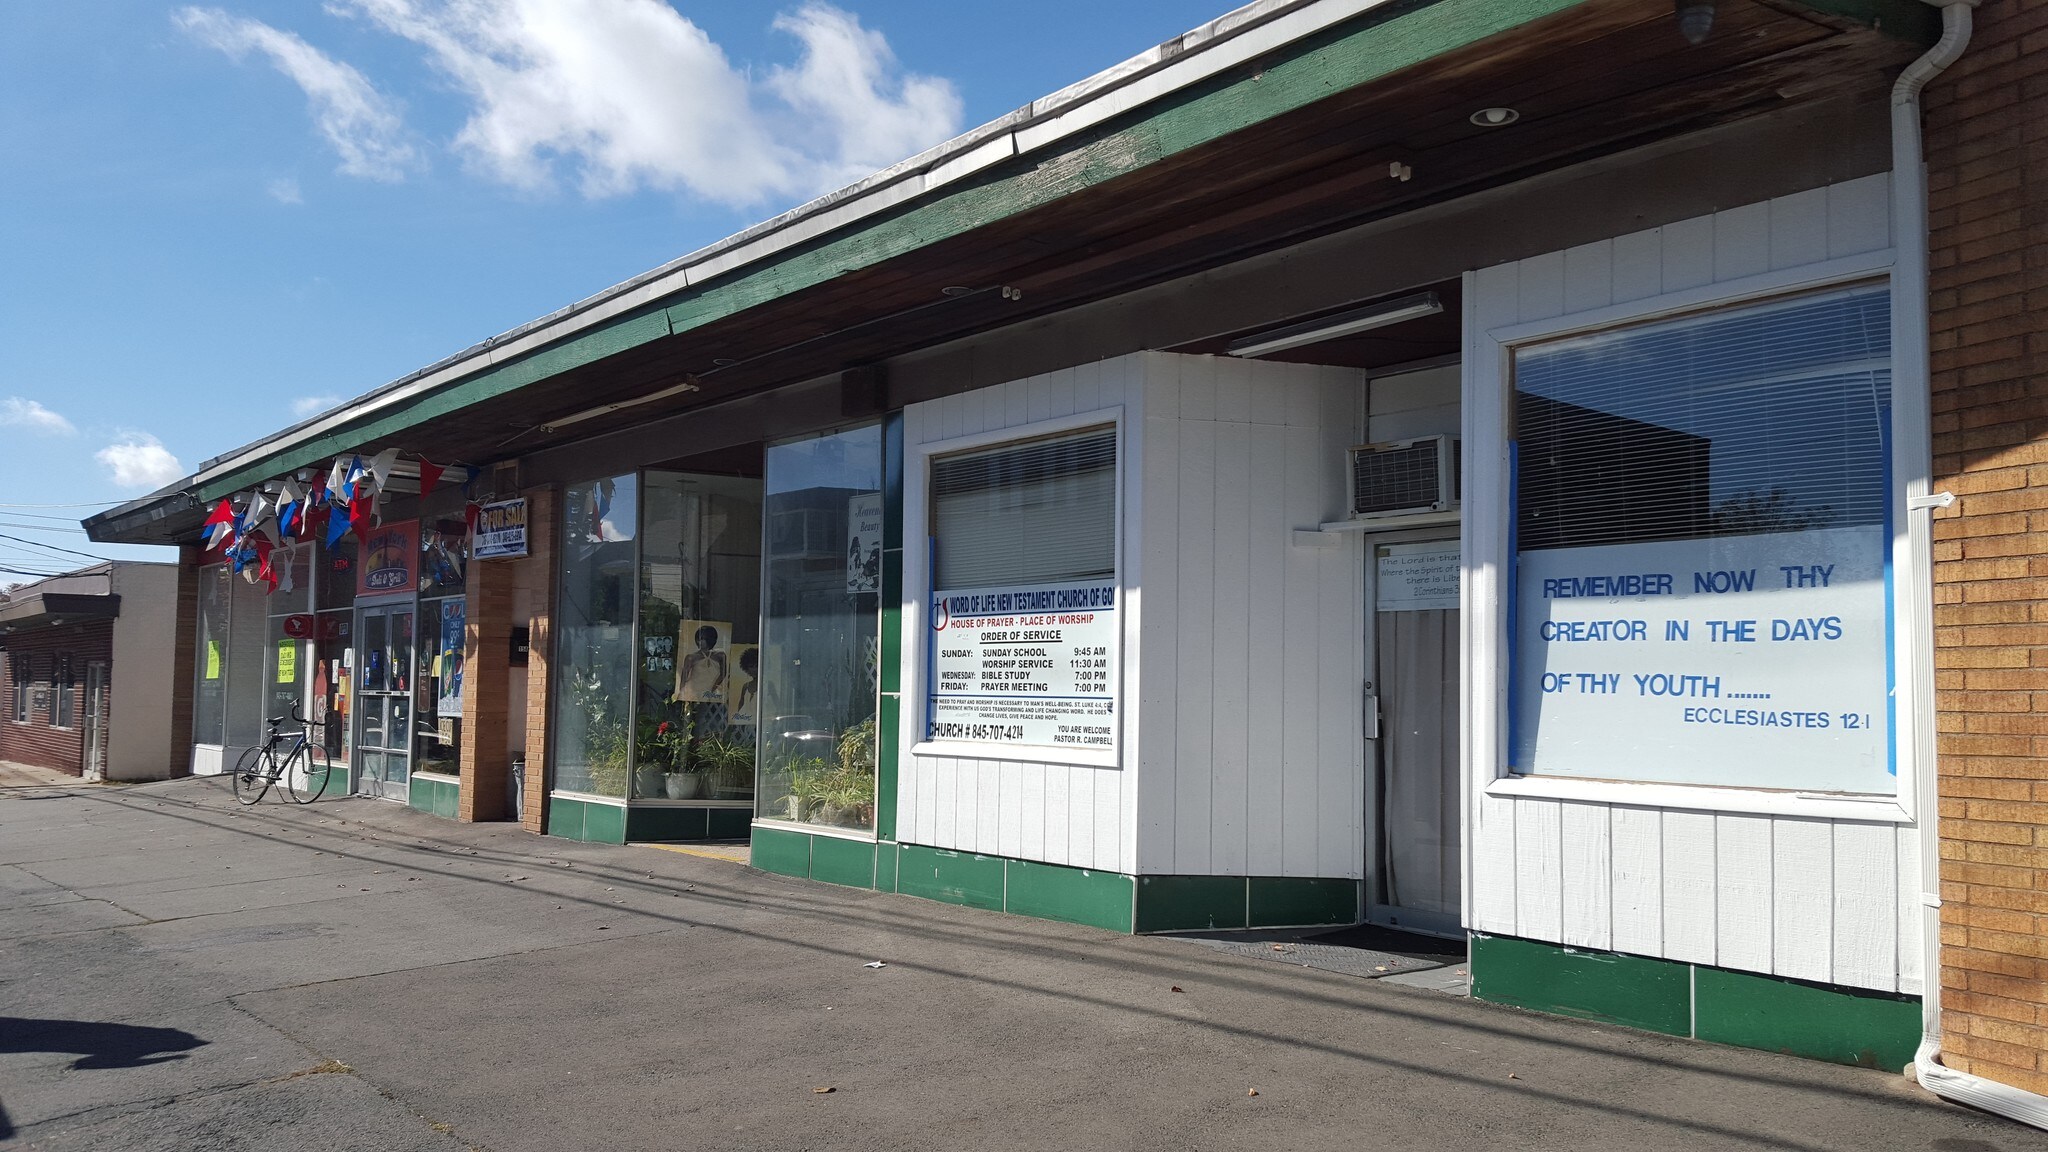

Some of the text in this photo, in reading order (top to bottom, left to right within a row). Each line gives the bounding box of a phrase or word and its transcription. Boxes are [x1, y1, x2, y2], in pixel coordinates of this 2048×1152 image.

[860, 521, 880, 533] Beauty
[1382, 558, 1398, 566] The
[1401, 556, 1424, 565] Lord
[1426, 555, 1436, 563] is
[1381, 568, 1404, 577] Where
[1405, 567, 1420, 576] the
[1420, 566, 1443, 576] Spirit
[1445, 564, 1454, 573] of
[1406, 576, 1430, 585] there
[1432, 575, 1441, 583] is
[1543, 564, 1835, 599] REMEMBER NOW THY
[950, 596, 970, 614] WORD
[971, 595, 980, 613] OF
[981, 594, 996, 612] LIFE
[997, 593, 1013, 611] NEW
[1014, 590, 1056, 610] TESTAMENT
[1057, 588, 1088, 609] CHURCH
[1090, 587, 1100, 607] OF
[951, 619, 975, 629] HOUSE
[976, 619, 984, 628] OF
[987, 617, 1014, 628] PRAYER
[1019, 615, 1044, 626] PLACE
[1046, 615, 1056, 625] OF
[1058, 613, 1095, 625] WORSHIP
[981, 629, 1062, 641] ORDER OF SERVICE
[1540, 616, 1843, 643] CREATOR IN THE DAYS
[941, 646, 1106, 658] SUNDAY: SUNDAY SCHOOL 9:45 AM
[982, 659, 1106, 669] WORSHIP SERVICE 11:30 AM
[941, 671, 1106, 680] WEDNESDAY: BIBLE STUDY 7:00 PM
[940, 682, 1106, 692] FRIDAY: PRAYER MEETING 7:00 PM
[1540, 672, 1572, 694] OF
[1575, 673, 1620, 695] THY
[1683, 707, 1830, 729] ECCLESIASTES
[929, 722, 1023, 740] CHURCH # 845-707-4214
[1058, 725, 1111, 735] YOU ARE WELCOME
[1053, 734, 1076, 743] PASTOR
[1076, 735, 1083, 744] R.
